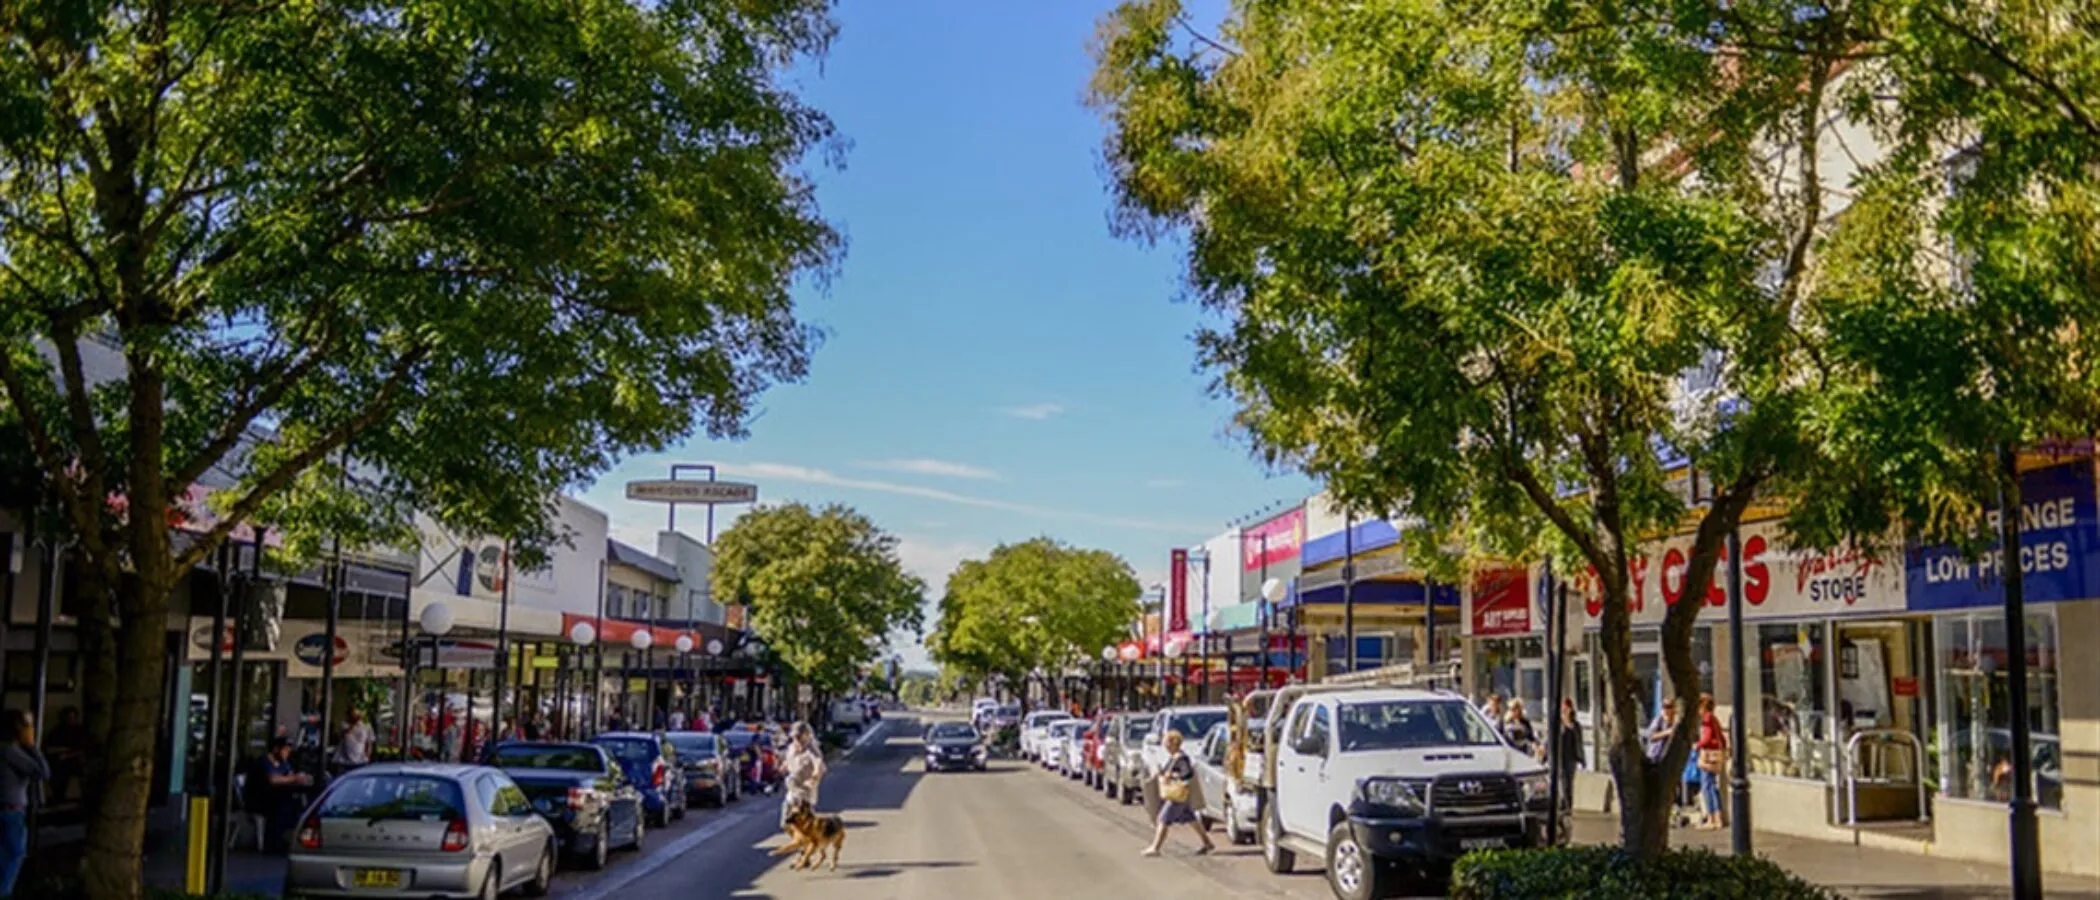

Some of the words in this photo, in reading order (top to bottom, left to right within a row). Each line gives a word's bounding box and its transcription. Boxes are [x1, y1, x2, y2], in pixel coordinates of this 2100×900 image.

[1987, 497, 2076, 536] RNGE
[1978, 541, 2069, 579] PRCES
[1810, 576, 1865, 602] STORE
